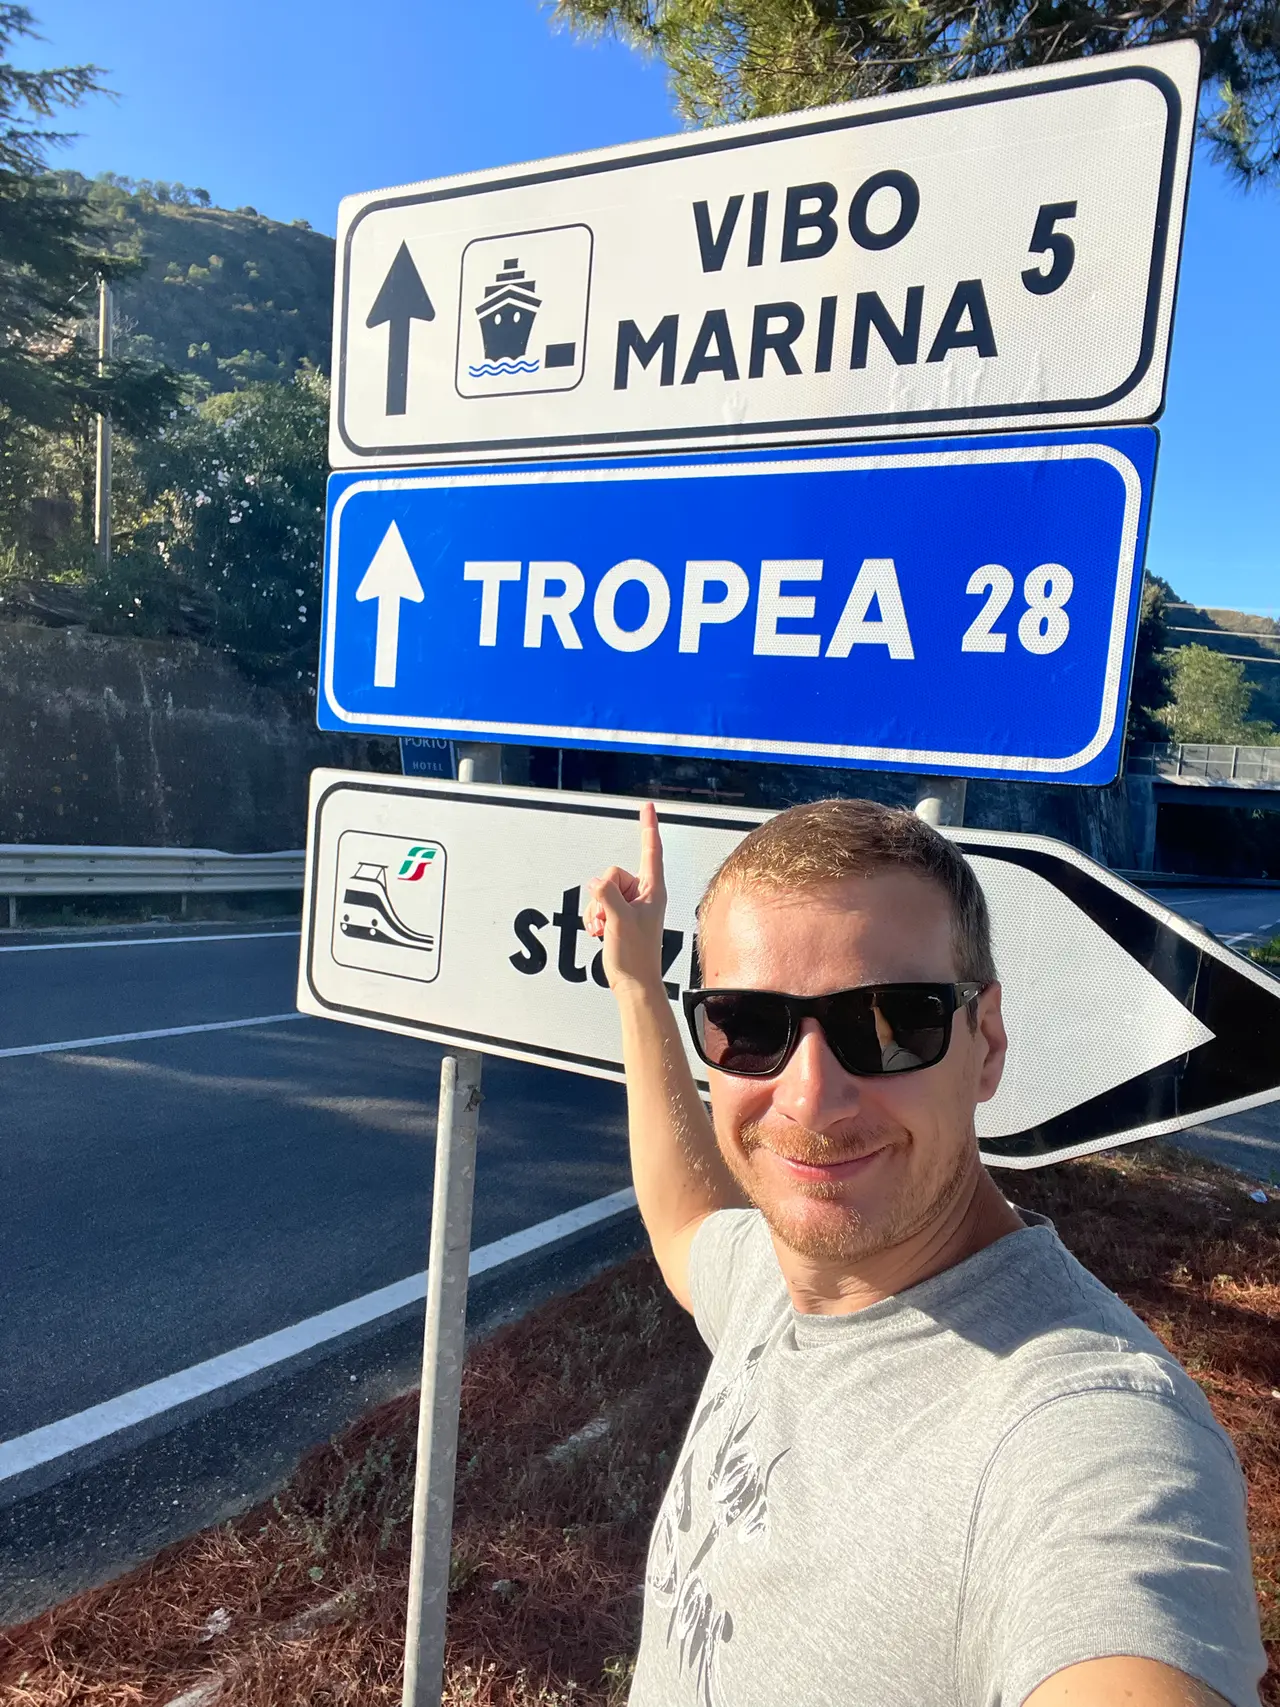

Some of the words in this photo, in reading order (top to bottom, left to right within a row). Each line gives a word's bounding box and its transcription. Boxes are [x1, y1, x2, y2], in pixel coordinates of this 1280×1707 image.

[692, 169, 920, 273] VIBO
[1020, 200, 1078, 296] 5
[613, 278, 999, 391] MARINA
[463, 558, 915, 660] TROPEA
[961, 562, 1074, 655] 28
[404, 737, 448, 750] PORTO
[412, 761, 444, 772] HOTEL
